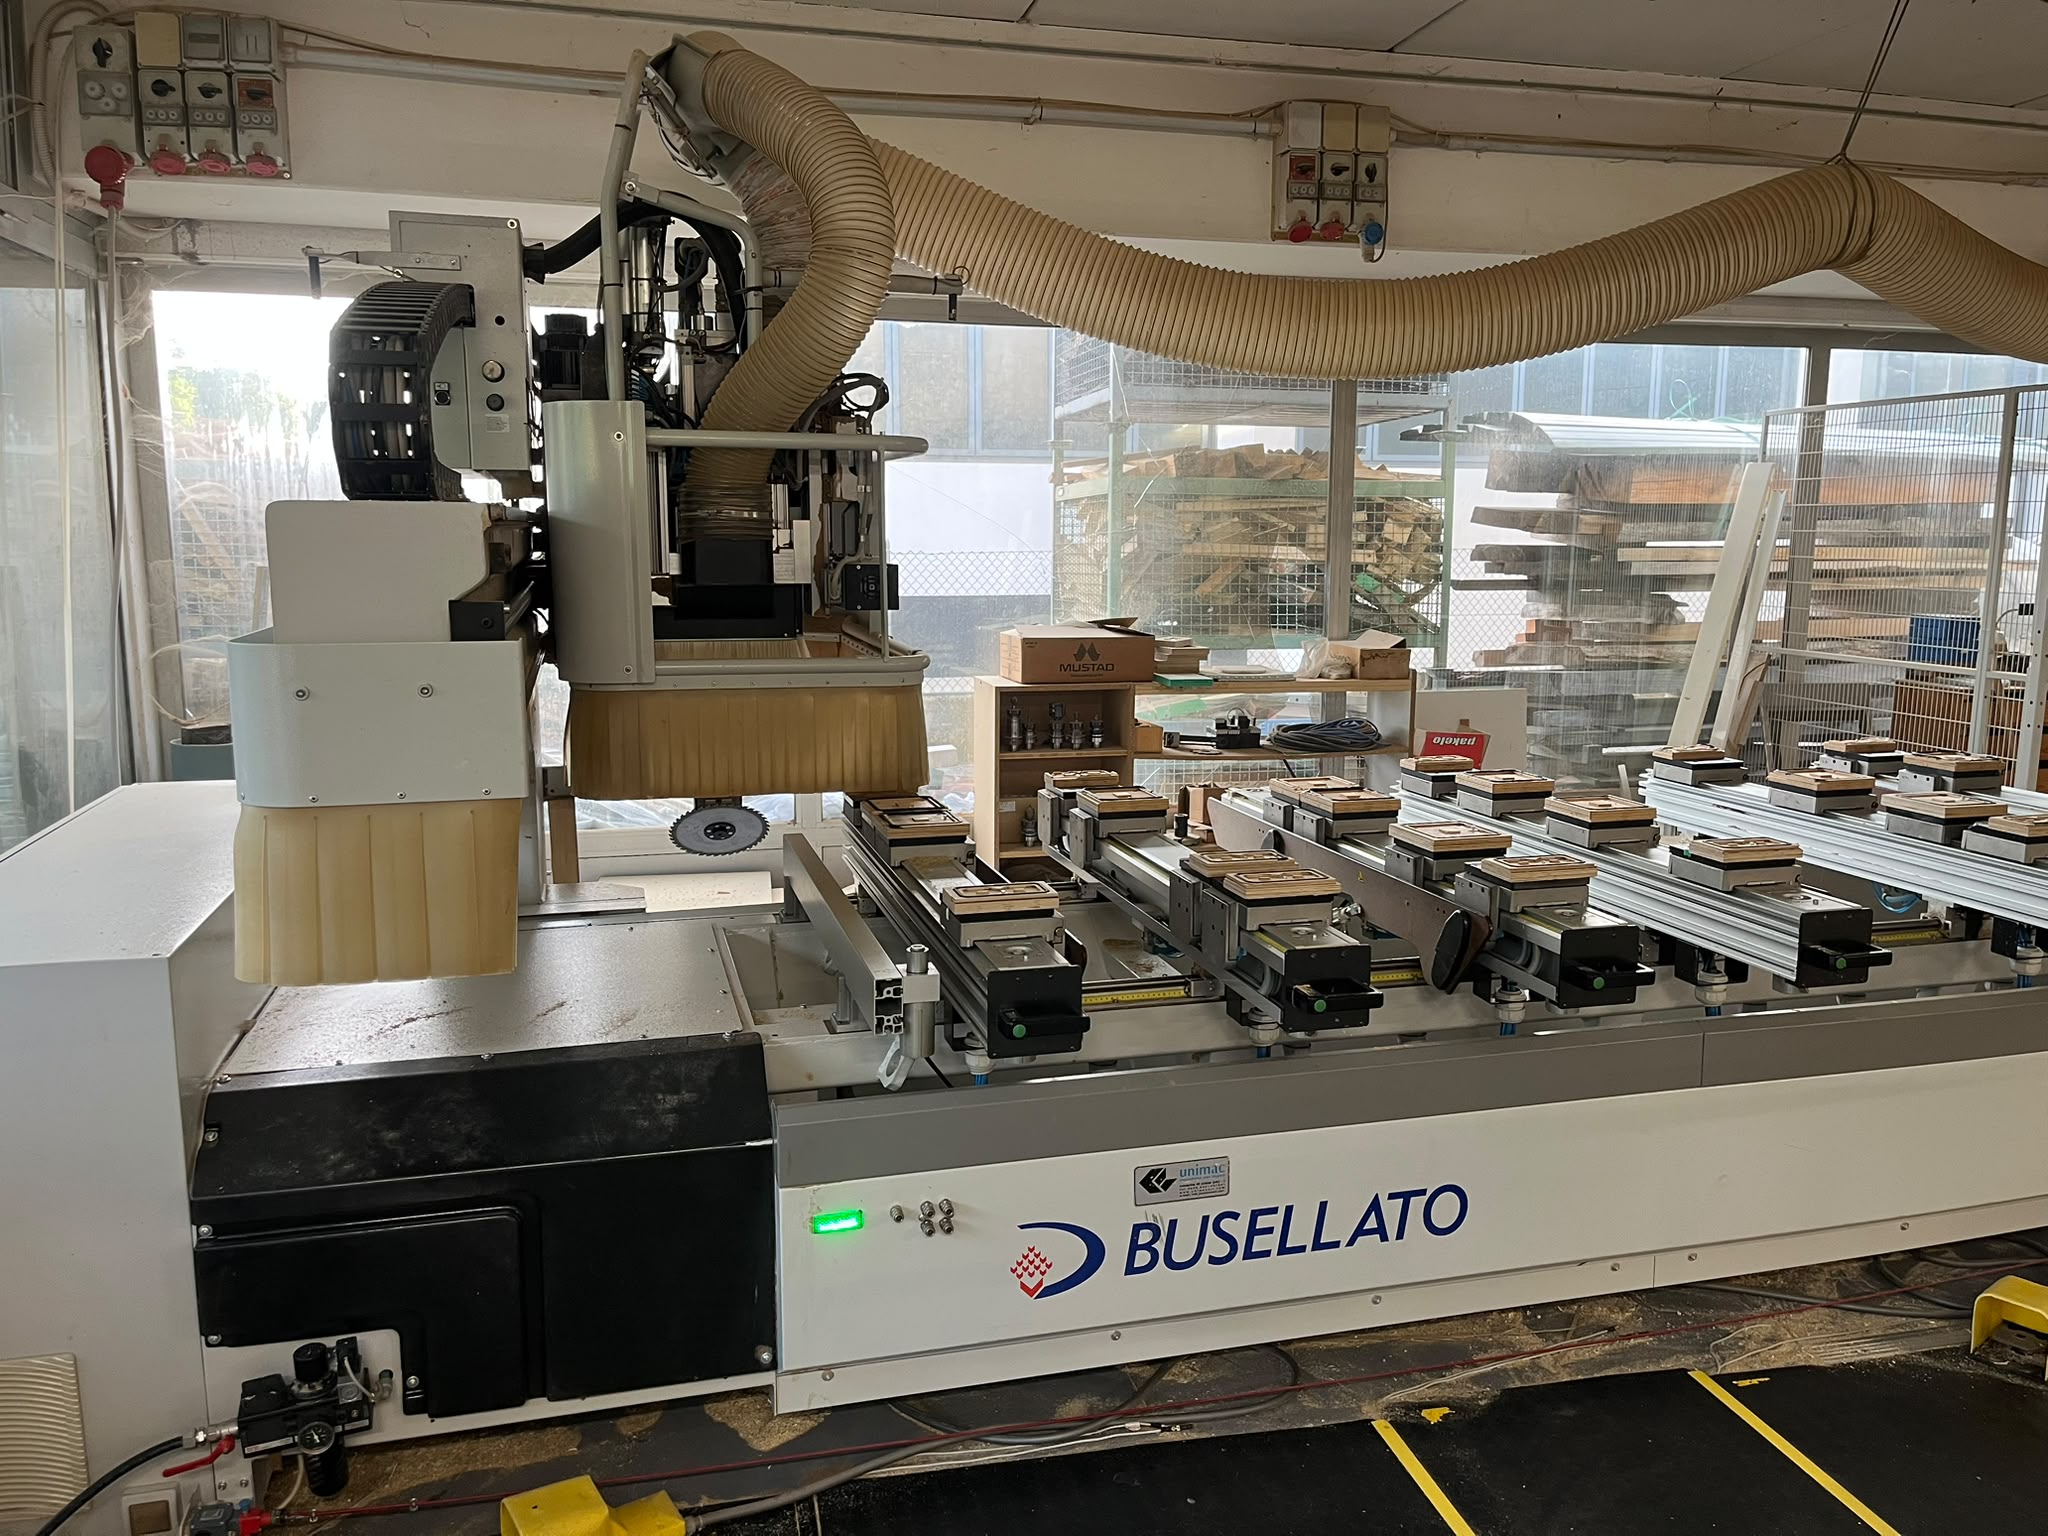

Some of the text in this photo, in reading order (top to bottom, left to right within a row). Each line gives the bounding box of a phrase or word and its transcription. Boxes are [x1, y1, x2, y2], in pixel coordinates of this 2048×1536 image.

[1060, 663, 1115, 672] MUSTAD
[1432, 736, 1477, 746] pakelo
[1179, 1163, 1225, 1178] unimac
[1124, 1183, 1469, 1276] BUSELLATO
